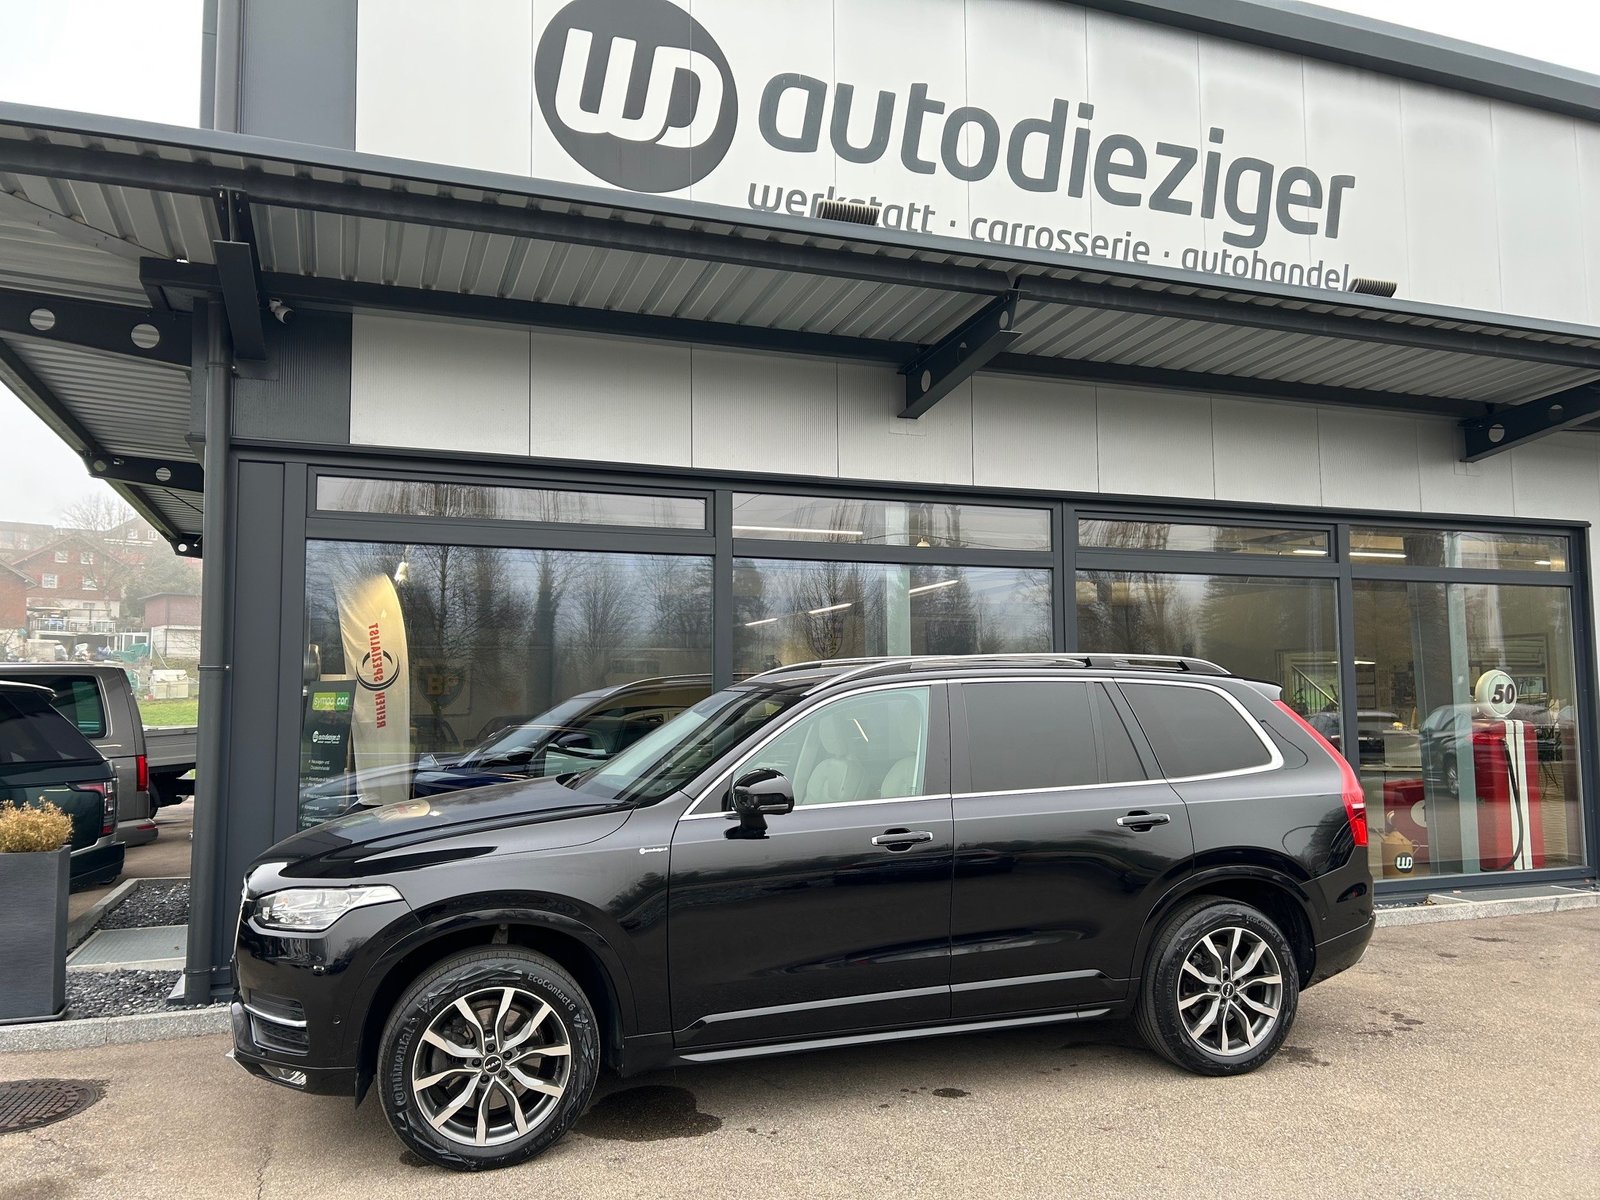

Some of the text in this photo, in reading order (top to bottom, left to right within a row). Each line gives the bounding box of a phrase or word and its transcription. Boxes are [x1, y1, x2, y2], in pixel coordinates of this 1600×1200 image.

[758, 72, 1356, 249] autodieziger
[970, 217, 1150, 264] carrosserie
[1181, 247, 1350, 292] autohandel
[1490, 683, 1515, 705] 50
[527, 972, 576, 1011] EcoContact 6
